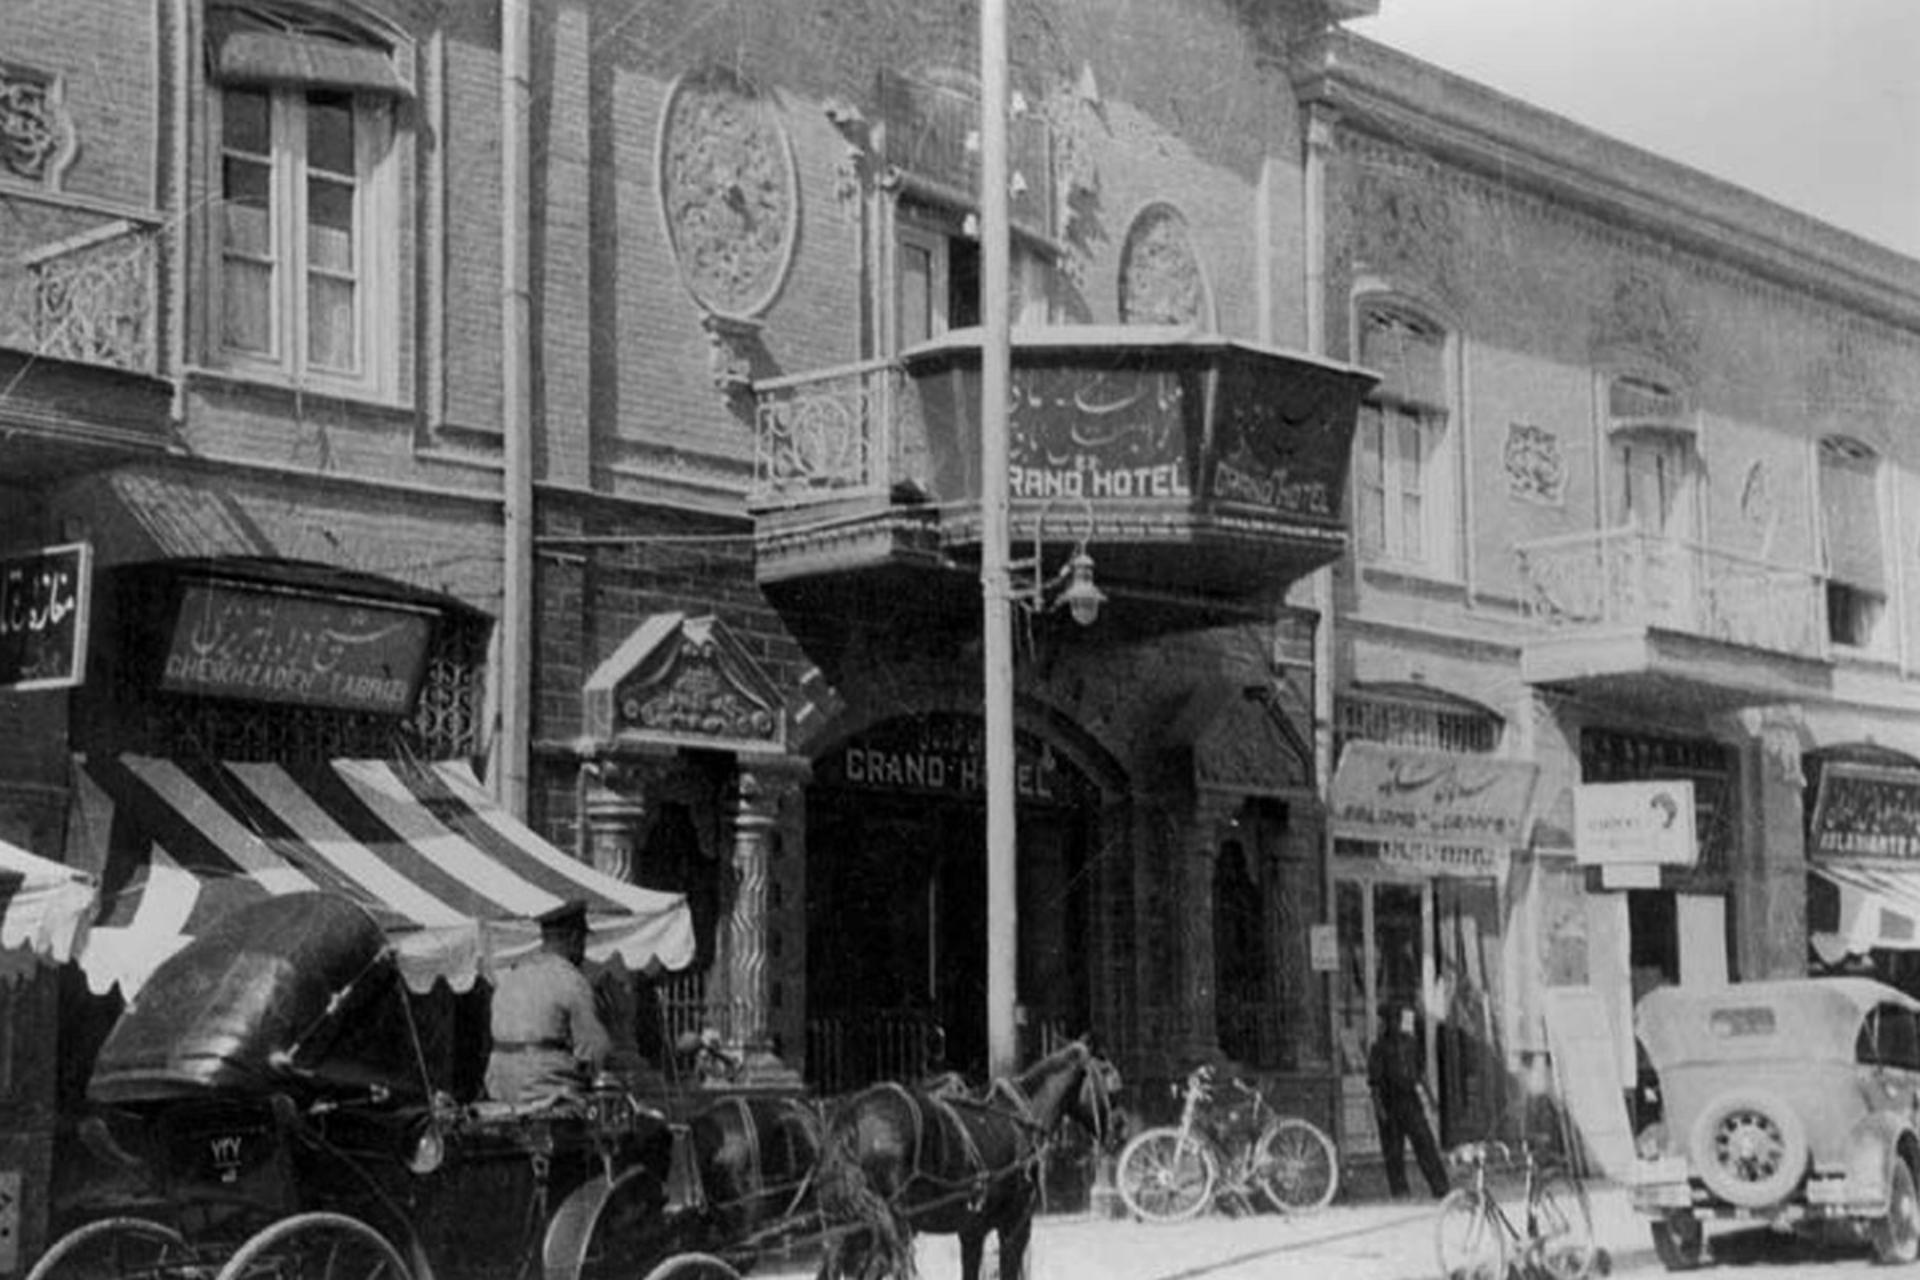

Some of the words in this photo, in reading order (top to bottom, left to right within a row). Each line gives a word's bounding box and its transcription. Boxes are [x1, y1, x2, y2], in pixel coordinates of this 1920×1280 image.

[1009, 466, 1083, 497] RAND
[1092, 463, 1191, 497] HOTEL
[1214, 460, 1274, 505] GRAND
[1275, 481, 1330, 513] HOTEL
[846, 748, 944, 788] GRAND
[961, 756, 1052, 798] HEL
